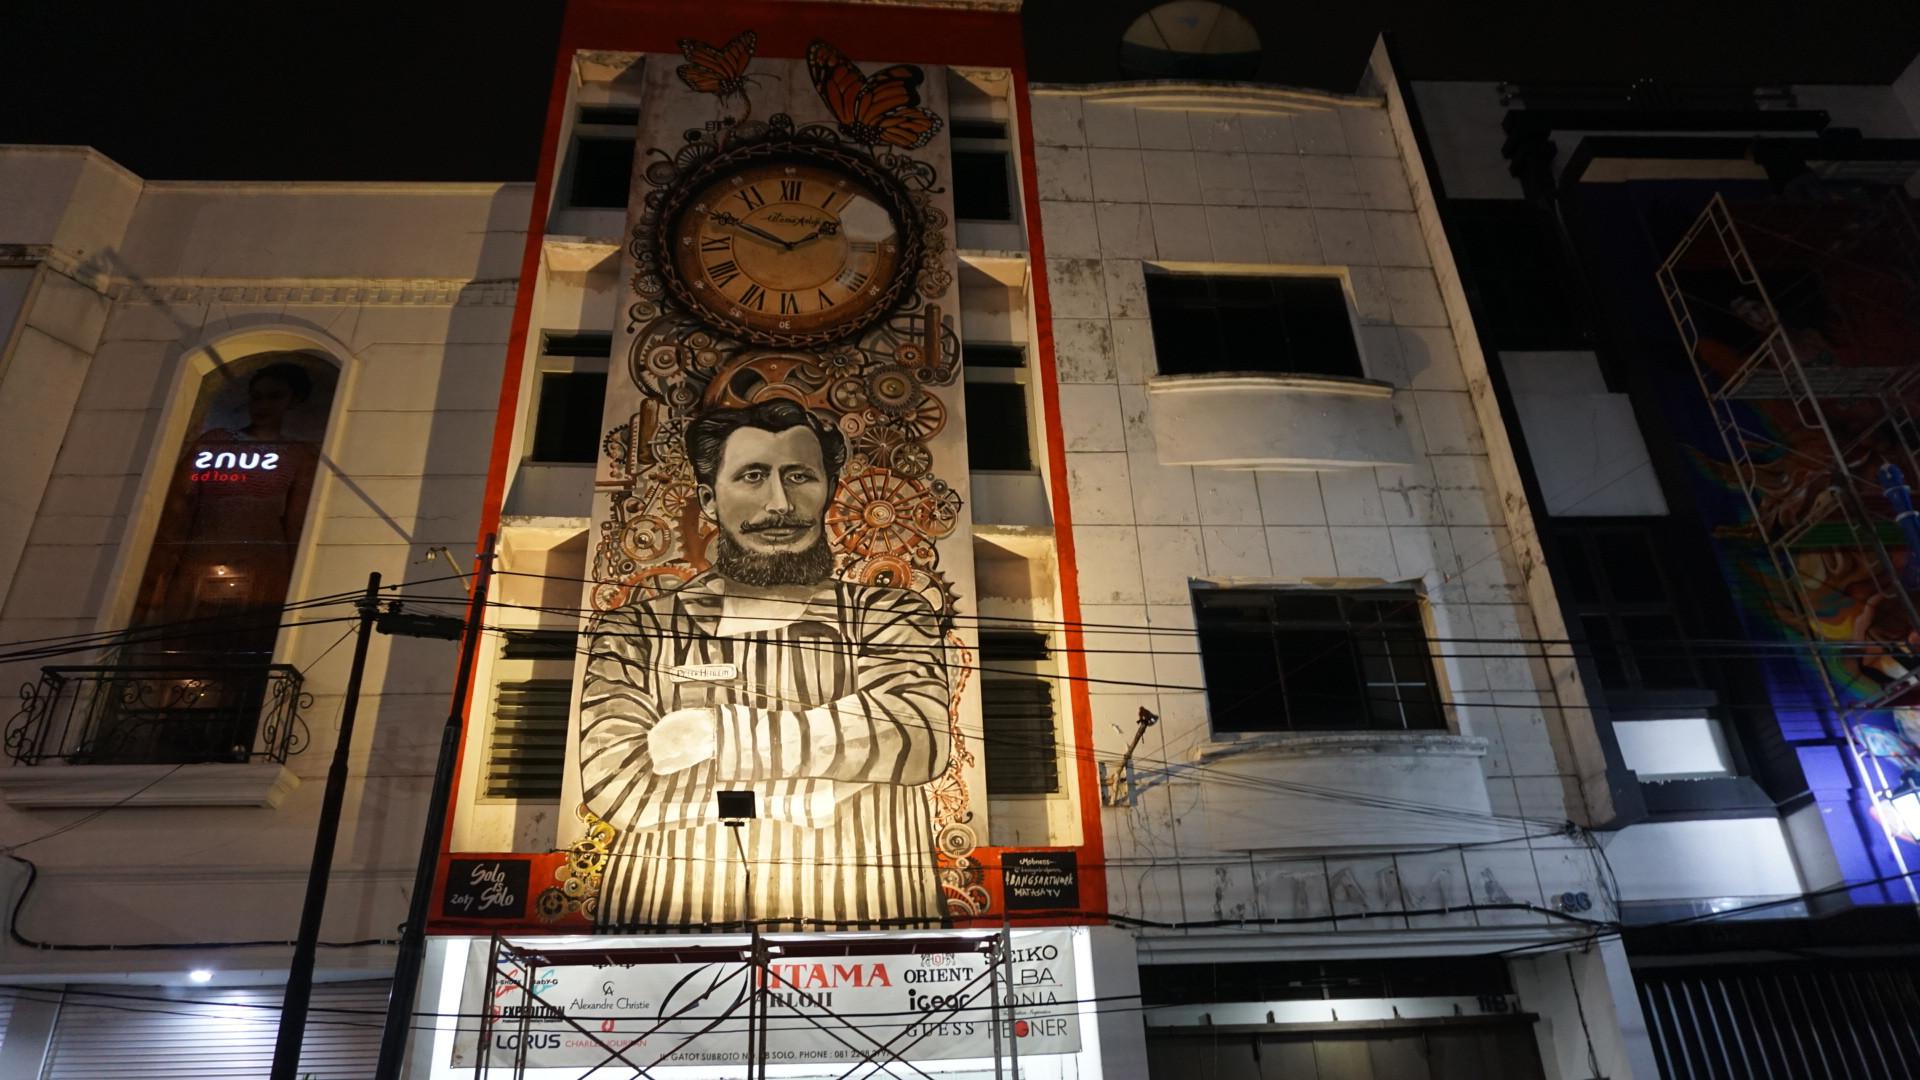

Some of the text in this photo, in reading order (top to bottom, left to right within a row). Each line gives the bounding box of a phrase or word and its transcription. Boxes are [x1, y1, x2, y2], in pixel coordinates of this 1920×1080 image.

[469, 863, 506, 886] Solo
[477, 886, 515, 911] Solo
[755, 963, 893, 989] UTAMA
[904, 967, 974, 984] ORIENT
[569, 997, 650, 1010] Alexandre Christie
[993, 991, 1057, 1007] ONIA
[503, 1005, 565, 1018] EXPDITION
[905, 1022, 975, 1037] GUESS
[496, 1034, 561, 1050] LORUS
[565, 1039, 605, 1048] CHARLE
[671, 1052, 699, 1061] GATOT
[702, 1052, 739, 1061] SUBROTO
[799, 1050, 828, 1059] PHONE
